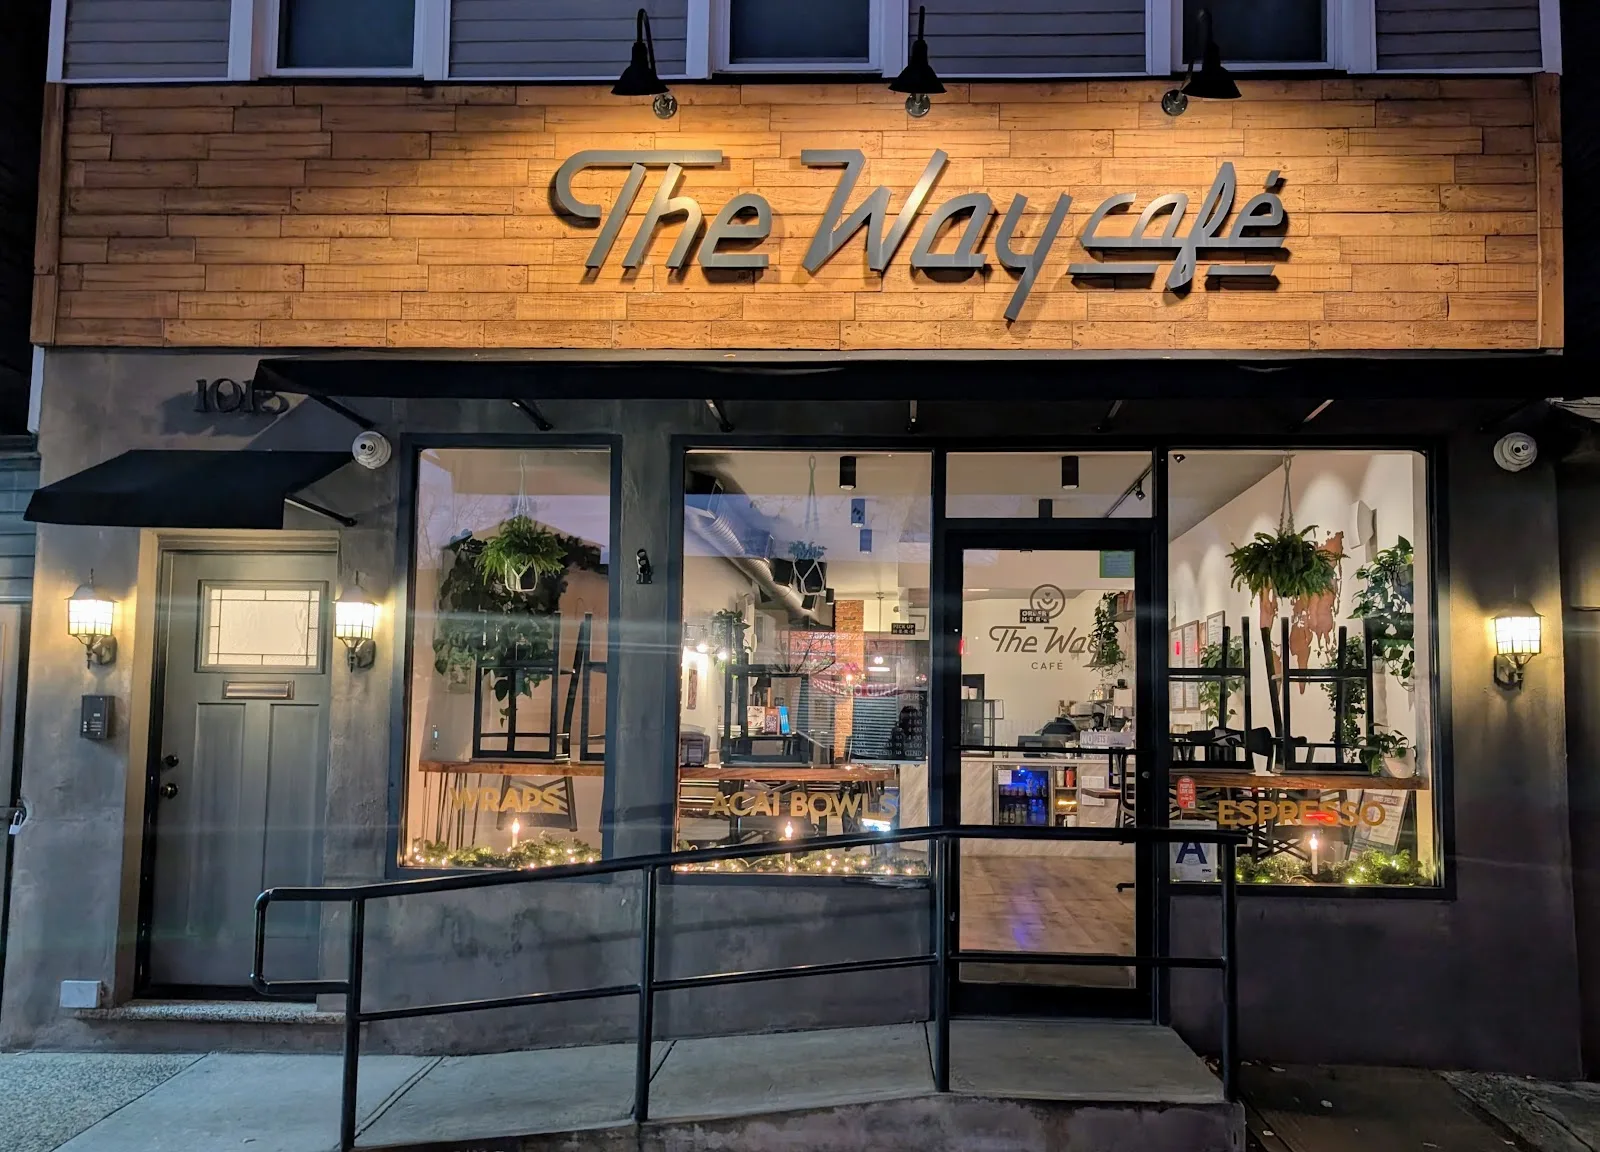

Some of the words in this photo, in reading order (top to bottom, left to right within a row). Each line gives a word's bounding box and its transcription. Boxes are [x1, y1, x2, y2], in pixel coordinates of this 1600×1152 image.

[554, 149, 773, 271] The
[801, 147, 1072, 322] Way
[1078, 162, 1285, 290] café
[989, 626, 1038, 653] The
[1031, 660, 1064, 670] CAFÉ
[1081, 734, 1093, 743] NO
[450, 787, 561, 813] WRAPS
[708, 791, 781, 817] ACAI
[790, 792, 898, 820] BOWLS
[1218, 800, 1386, 827] ESPRESSO
[1175, 842, 1207, 865] A
